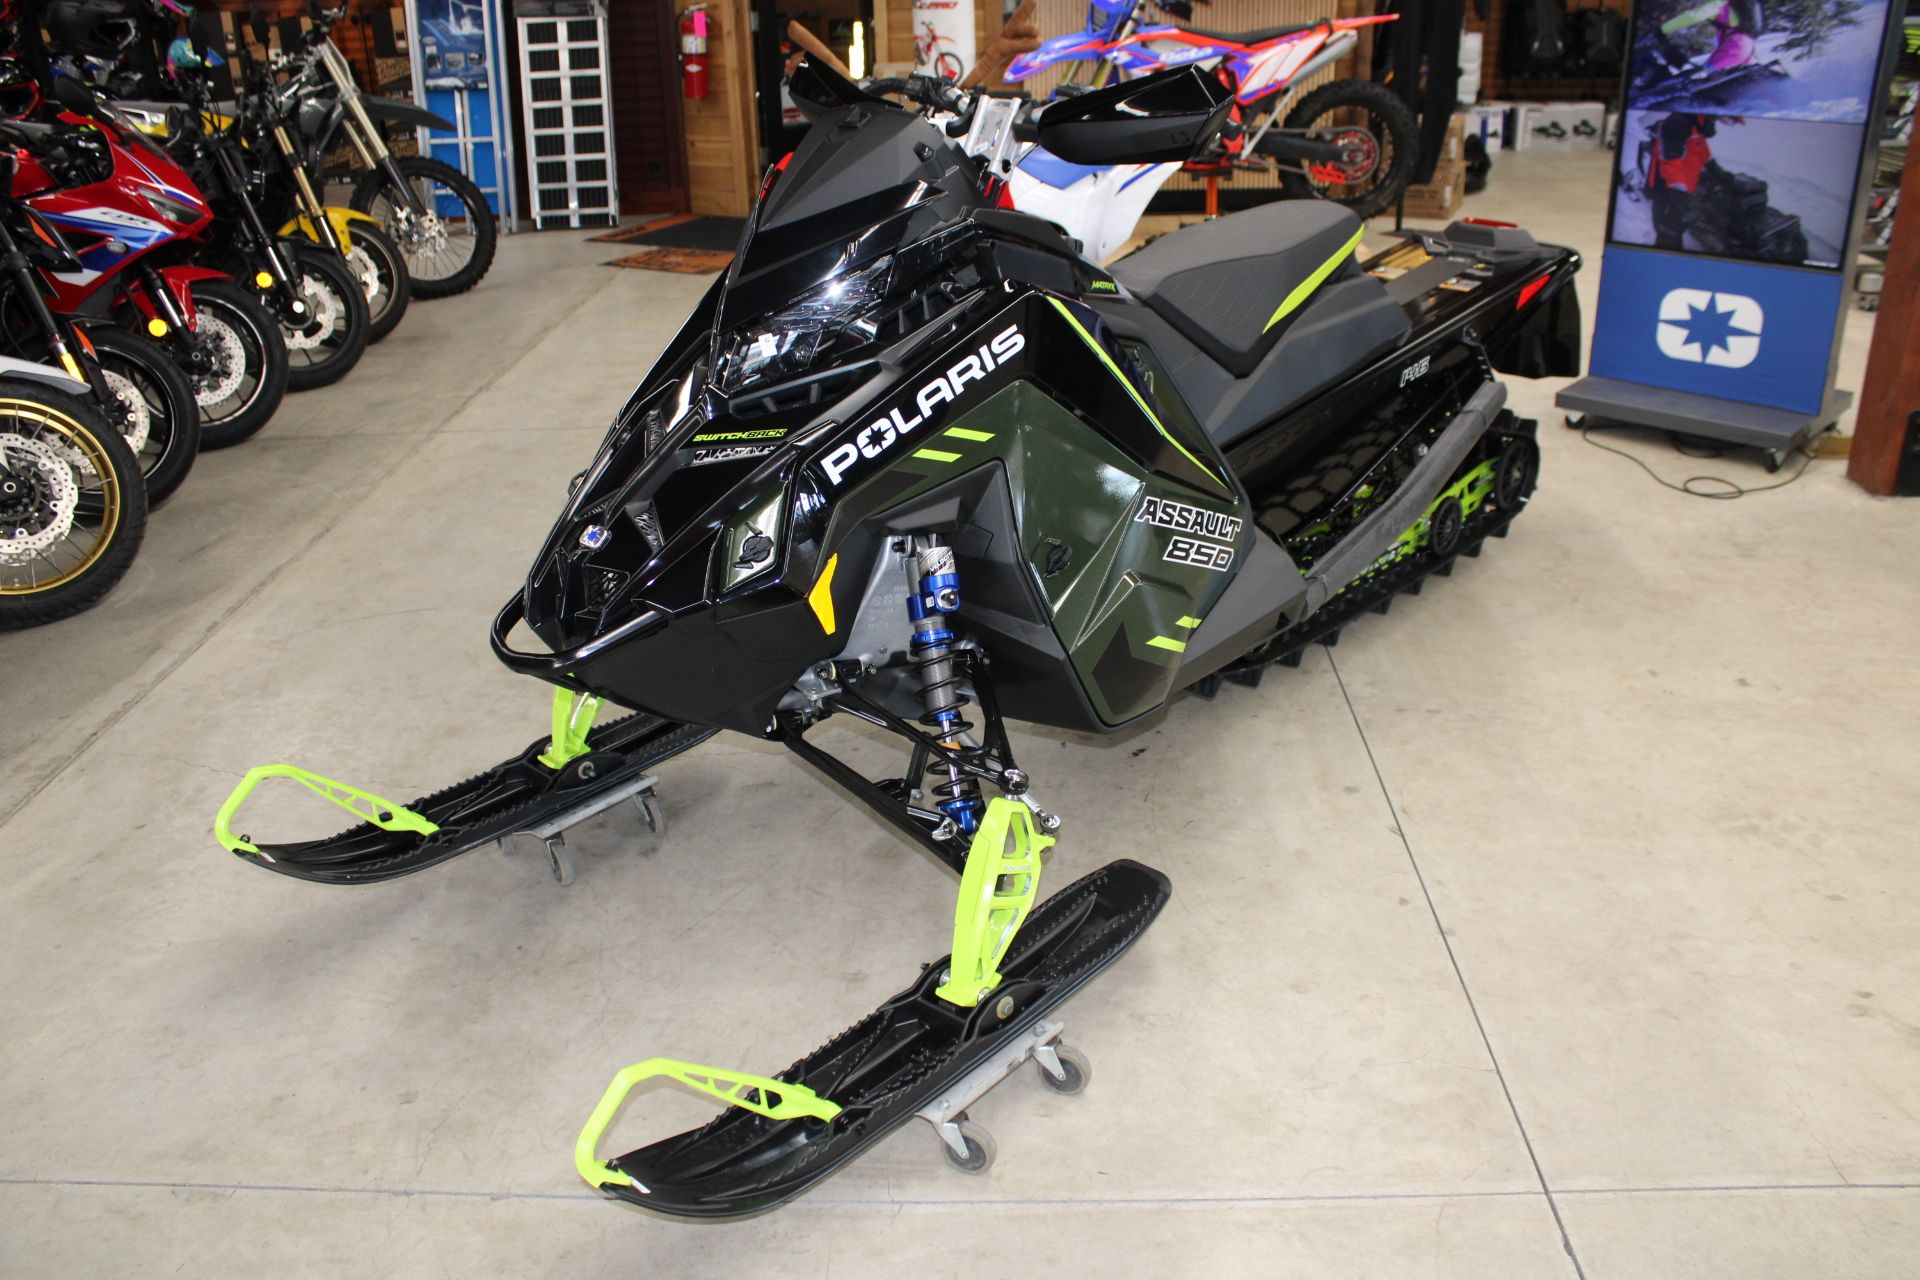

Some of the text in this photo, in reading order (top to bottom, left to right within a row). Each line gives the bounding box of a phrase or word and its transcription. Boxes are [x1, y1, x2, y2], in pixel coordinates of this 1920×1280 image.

[820, 323, 1026, 486] POLARIS
[692, 428, 788, 442] SWITCHBACK
[1133, 495, 1243, 542] ASSAULT
[1162, 535, 1235, 572] 850
